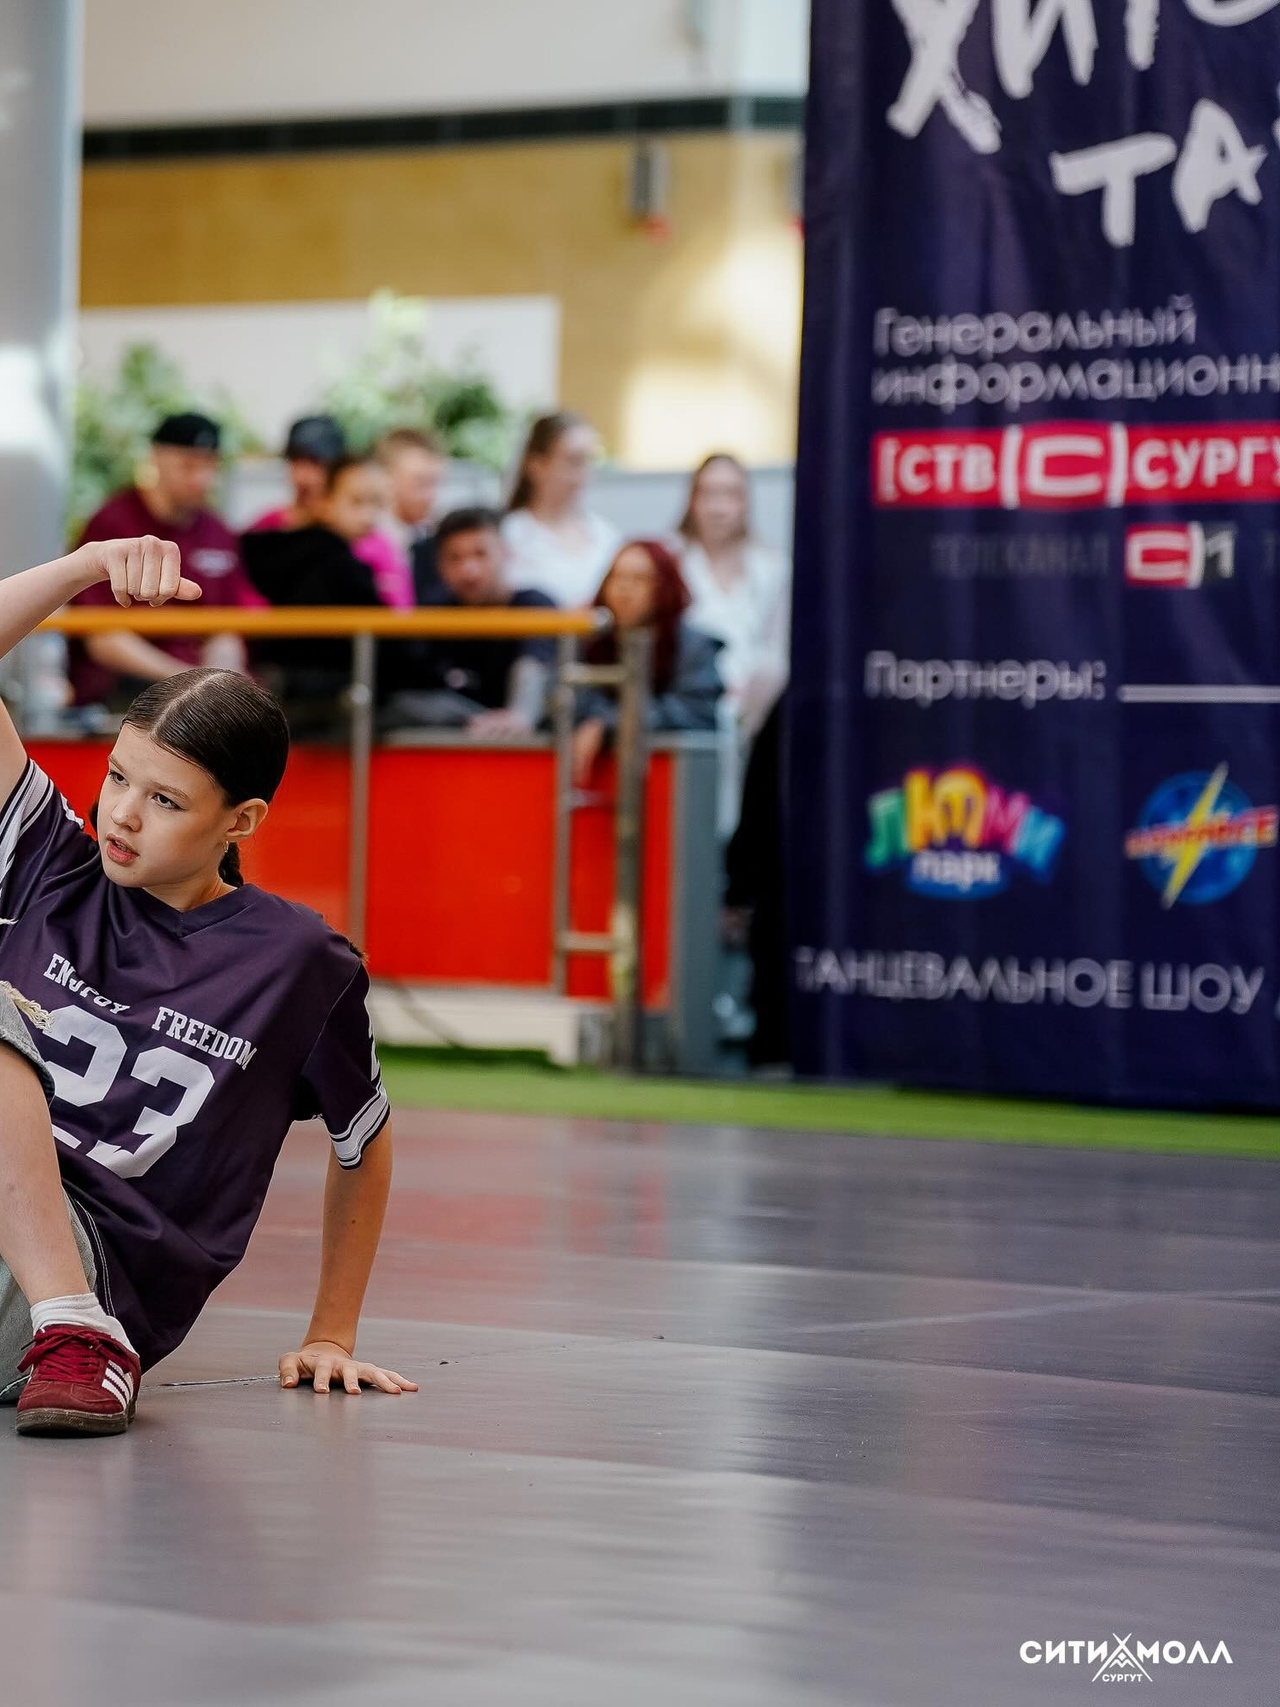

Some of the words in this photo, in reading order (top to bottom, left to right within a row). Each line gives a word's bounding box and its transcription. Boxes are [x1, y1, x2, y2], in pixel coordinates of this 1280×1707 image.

[1049, 99, 1280, 248] ТА
[874, 294, 1197, 357] Генеральный
[865, 651, 1106, 707] Партнеры:
[1140, 962, 1265, 1014] ШОУ
[151, 1006, 258, 1070] FREEDOM
[42, 1004, 215, 1179] 23
